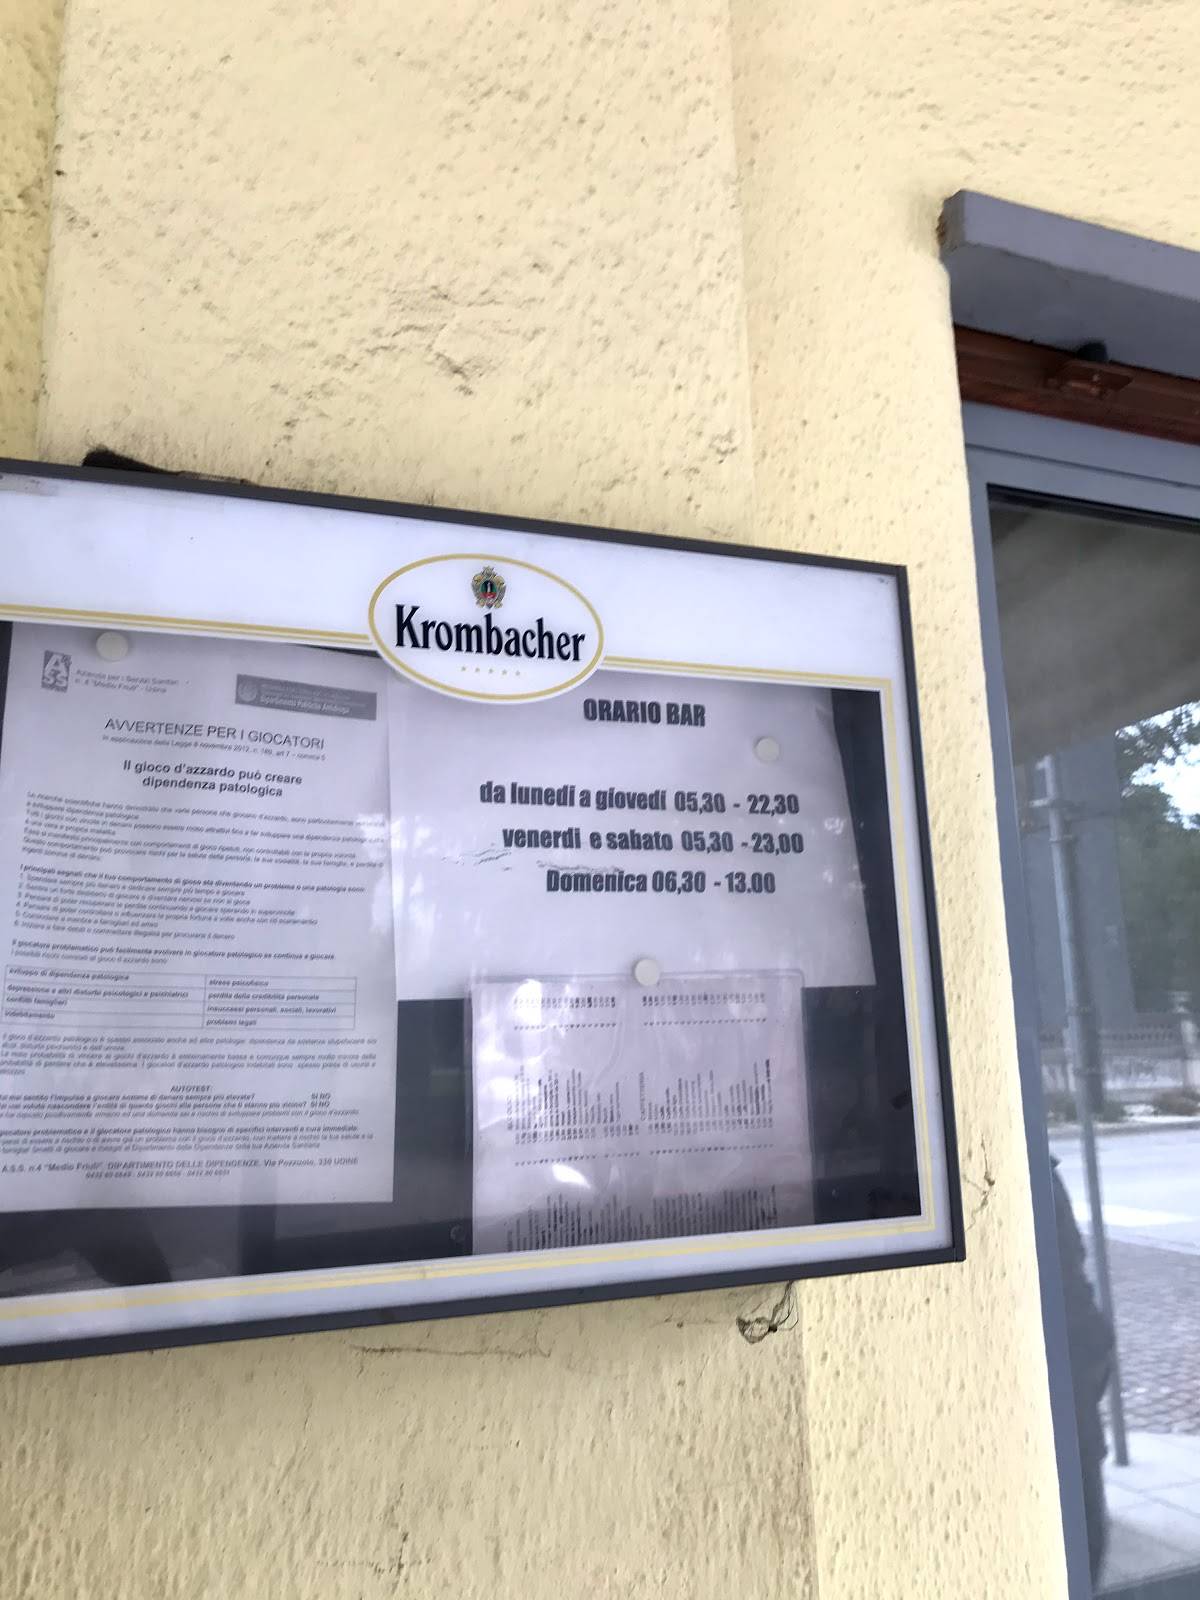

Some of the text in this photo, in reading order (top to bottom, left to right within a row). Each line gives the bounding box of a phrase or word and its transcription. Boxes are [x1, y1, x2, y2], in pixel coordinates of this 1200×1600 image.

[395, 604, 585, 662] Krombacher
[583, 698, 706, 727] ORARIO BAR
[104, 718, 325, 750] AVVERTENZE PER I GIOCATORI
[123, 760, 303, 785] Il gioco d'azzardo può creare
[142, 776, 283, 798] dipendenza patologica
[479, 781, 506, 804] da
[579, 789, 592, 808] a
[674, 791, 726, 814] 05,30
[747, 794, 800, 817] 22,30
[589, 832, 602, 850] e
[605, 829, 673, 851] sabato
[681, 831, 734, 854] 05,30
[751, 833, 804, 856] 23,00
[546, 869, 648, 893] Domenica
[652, 871, 706, 895] 06,30
[725, 872, 776, 894] 13.00
